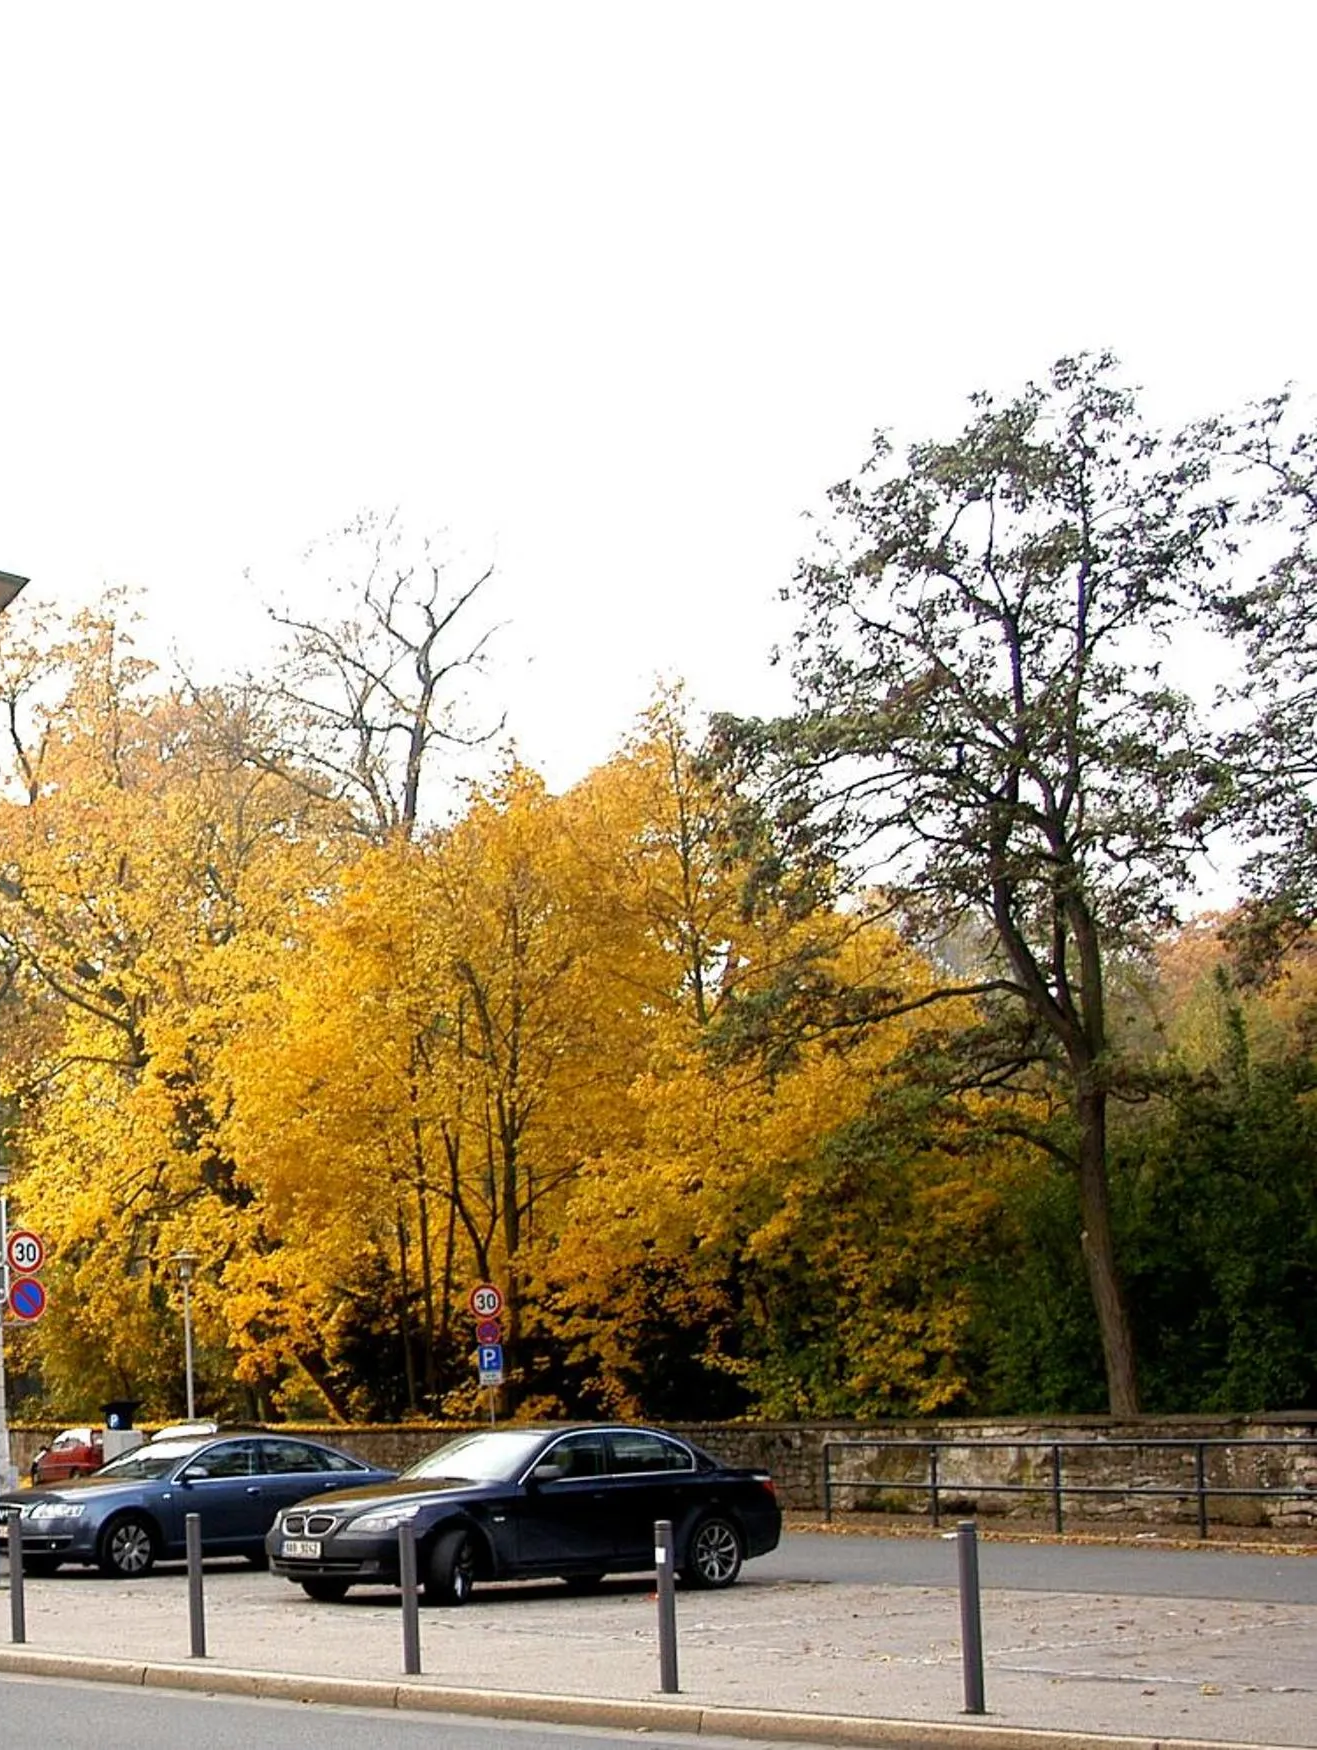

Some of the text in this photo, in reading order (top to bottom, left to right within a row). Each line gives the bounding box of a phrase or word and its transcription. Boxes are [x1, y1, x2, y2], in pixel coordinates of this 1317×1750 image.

[15, 1243, 37, 1262] 30
[476, 1293, 496, 1311] 30
[483, 1349, 496, 1369] P
[110, 1413, 119, 1428] P
